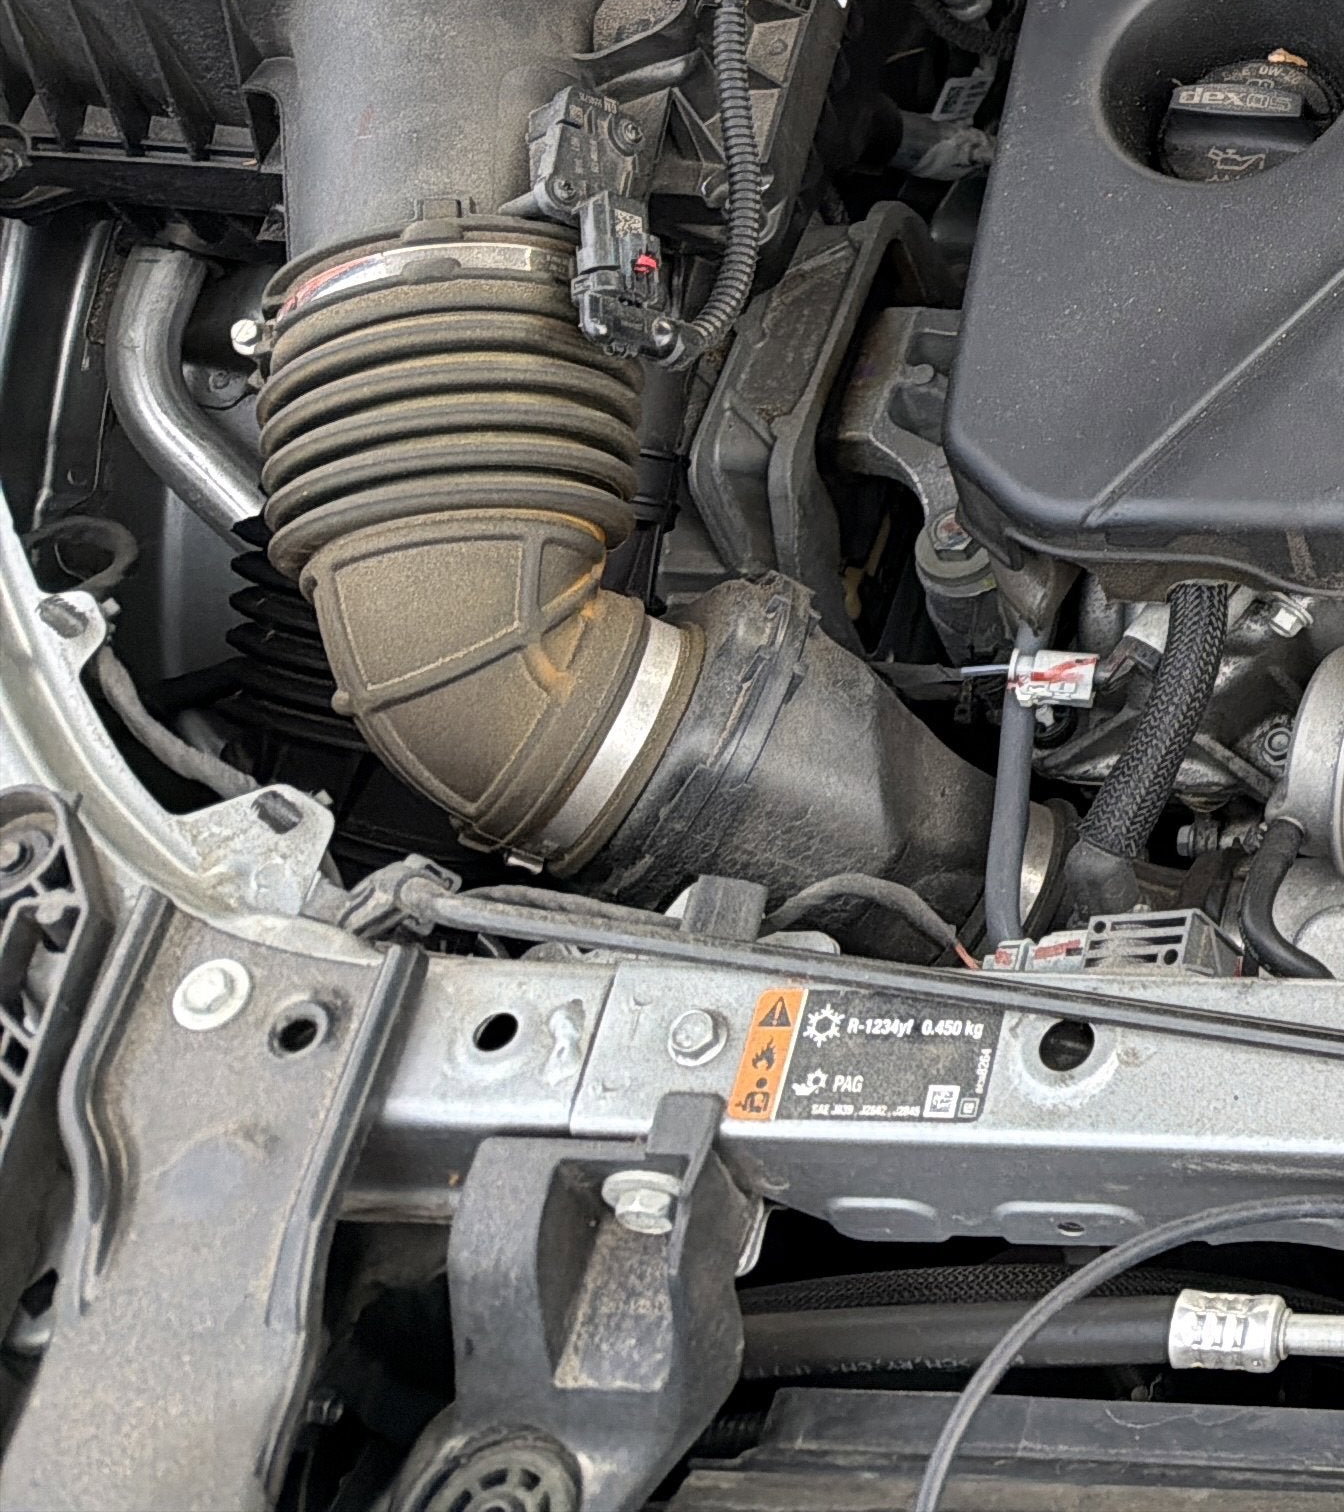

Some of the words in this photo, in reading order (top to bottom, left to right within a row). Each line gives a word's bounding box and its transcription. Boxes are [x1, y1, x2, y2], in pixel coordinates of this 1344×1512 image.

[1178, 87, 1292, 112] dexos
[846, 1019, 915, 1039] R-1234yf
[921, 1019, 962, 1036] 0.450
[965, 1021, 985, 1039] kg
[832, 1075, 864, 1092] PAG
